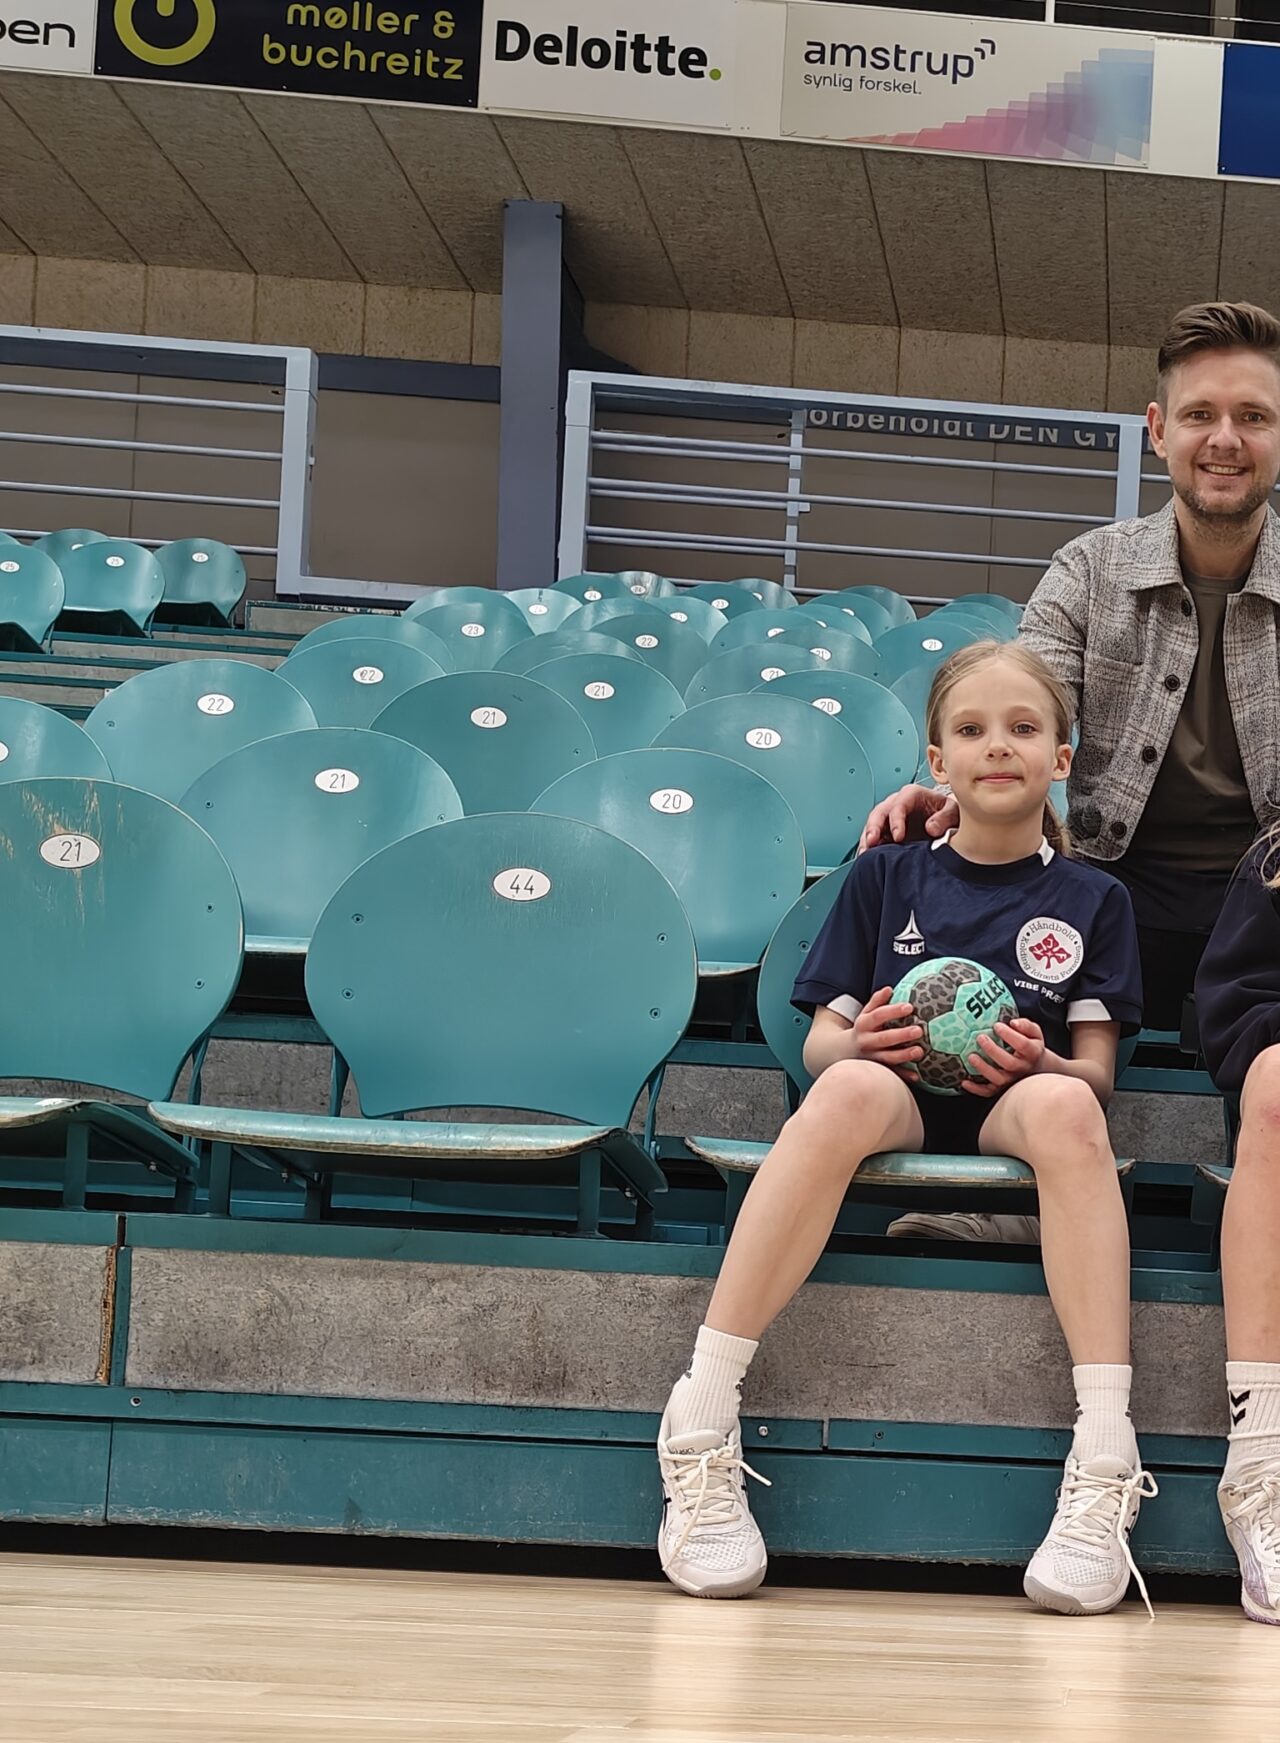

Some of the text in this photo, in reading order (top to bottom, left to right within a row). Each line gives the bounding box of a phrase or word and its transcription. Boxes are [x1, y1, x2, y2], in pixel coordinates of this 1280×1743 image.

[286, 1, 456, 39] møller &
[0, 19, 75, 48] en
[262, 33, 464, 80] buchreitz
[803, 40, 975, 85] amstrup
[803, 73, 922, 95] synlig forskel.
[467, 625, 479, 635] 23
[927, 640, 937, 650] 21
[593, 685, 606, 697] 21
[207, 697, 224, 712] 22
[482, 709, 498, 725] 21
[755, 731, 771, 746] 20
[329, 772, 346, 789] 21
[661, 792, 682, 810] 20
[60, 840, 83, 862] 21
[509, 873, 535, 893] 44
[1014, 979, 1040, 992] VIBE
